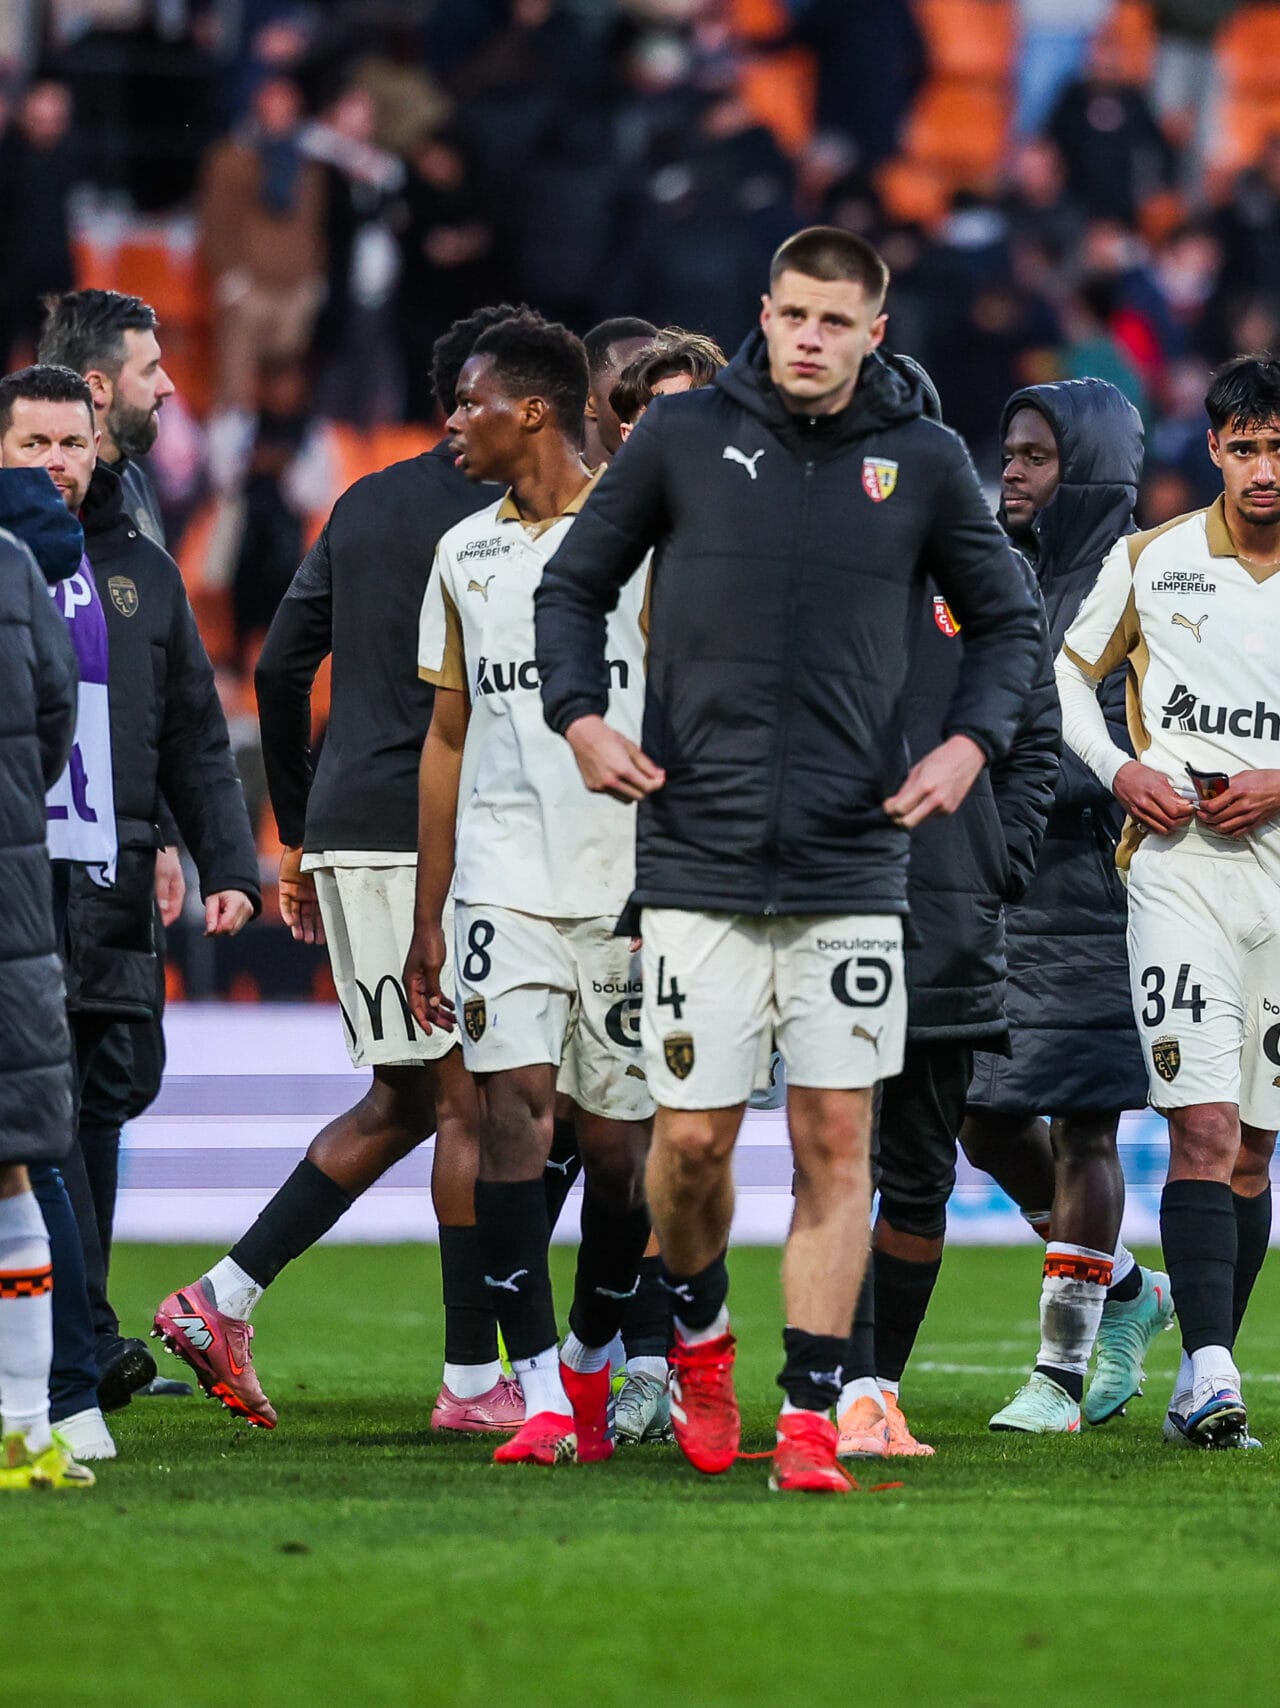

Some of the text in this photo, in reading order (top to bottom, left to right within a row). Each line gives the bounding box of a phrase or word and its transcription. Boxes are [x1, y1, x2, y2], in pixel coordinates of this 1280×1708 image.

[465, 536, 502, 551] GROUPE
[1151, 581, 1217, 593] LEMPEREUR
[1162, 571, 1205, 582] GROUPE
[463, 919, 495, 982] 8
[657, 955, 686, 1019] 4
[1141, 963, 1207, 1027] 34
